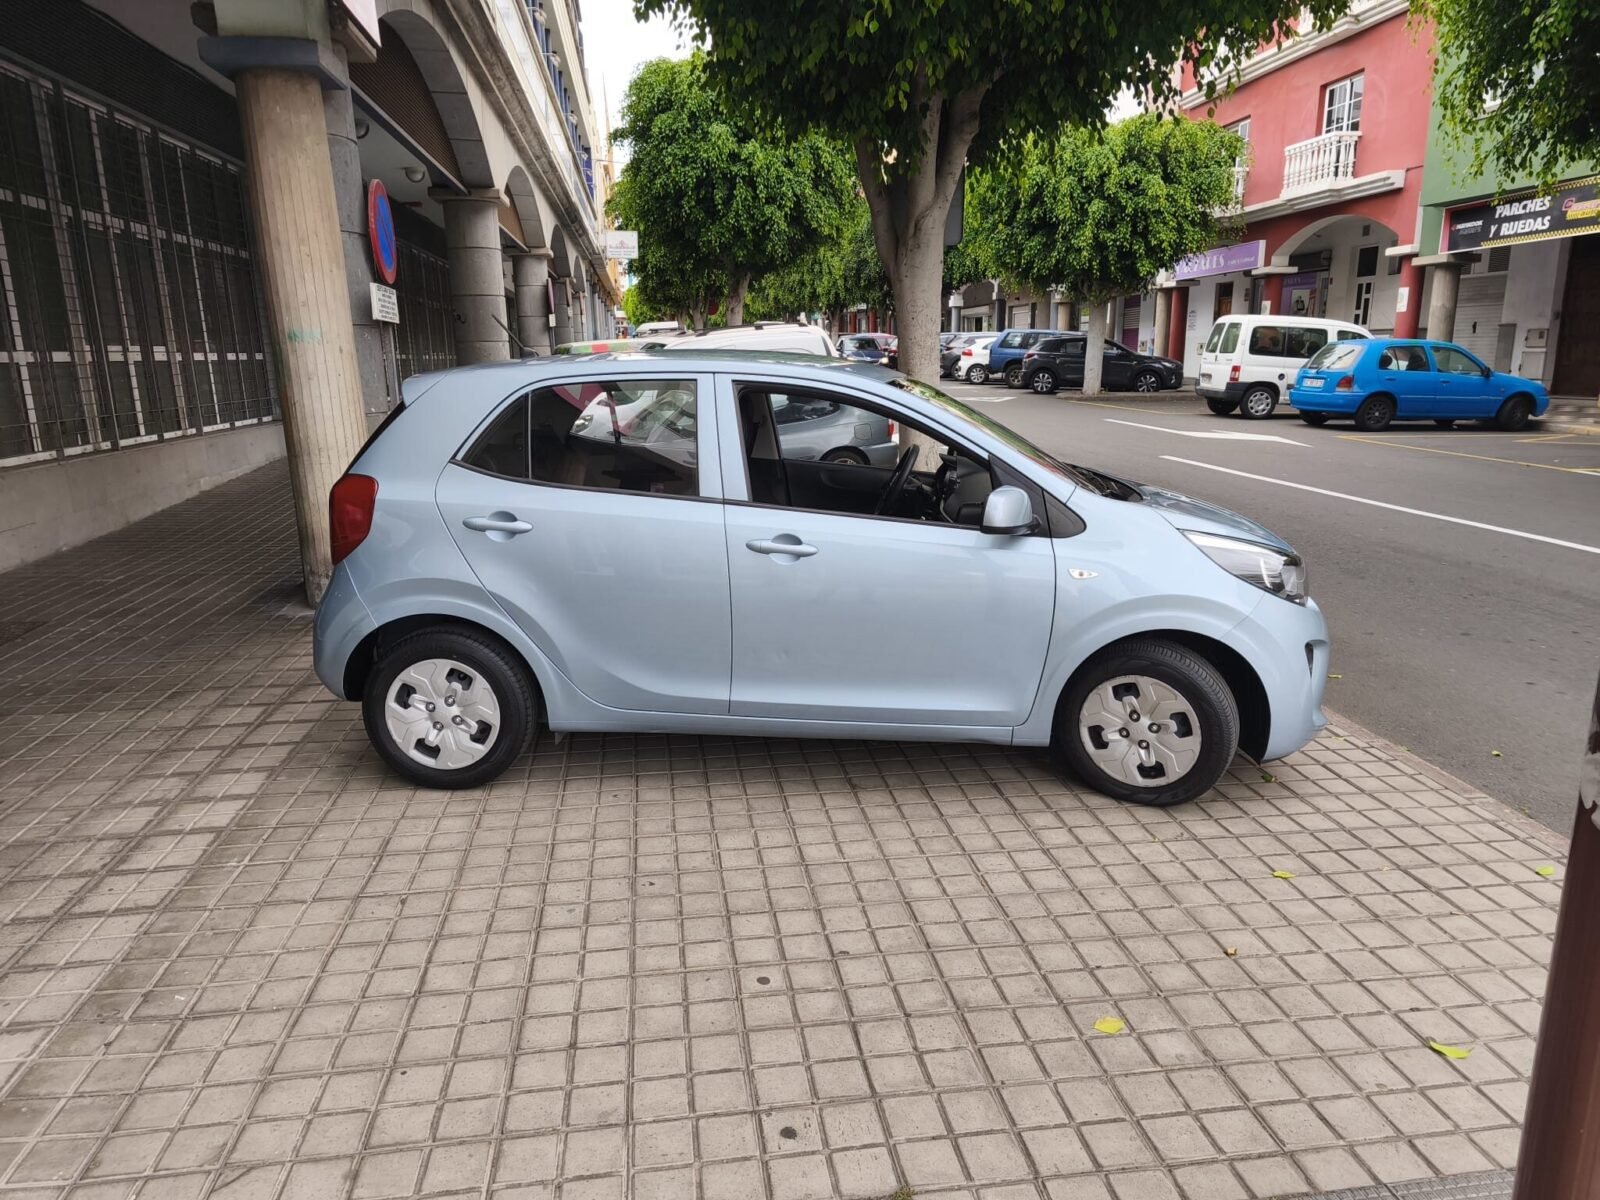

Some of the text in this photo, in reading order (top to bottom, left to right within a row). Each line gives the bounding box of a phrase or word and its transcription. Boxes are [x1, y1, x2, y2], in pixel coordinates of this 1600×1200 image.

[1495, 196, 1552, 218] PARCHES
[1489, 224, 1498, 238] Y
[1500, 215, 1551, 236] RUEDAS
